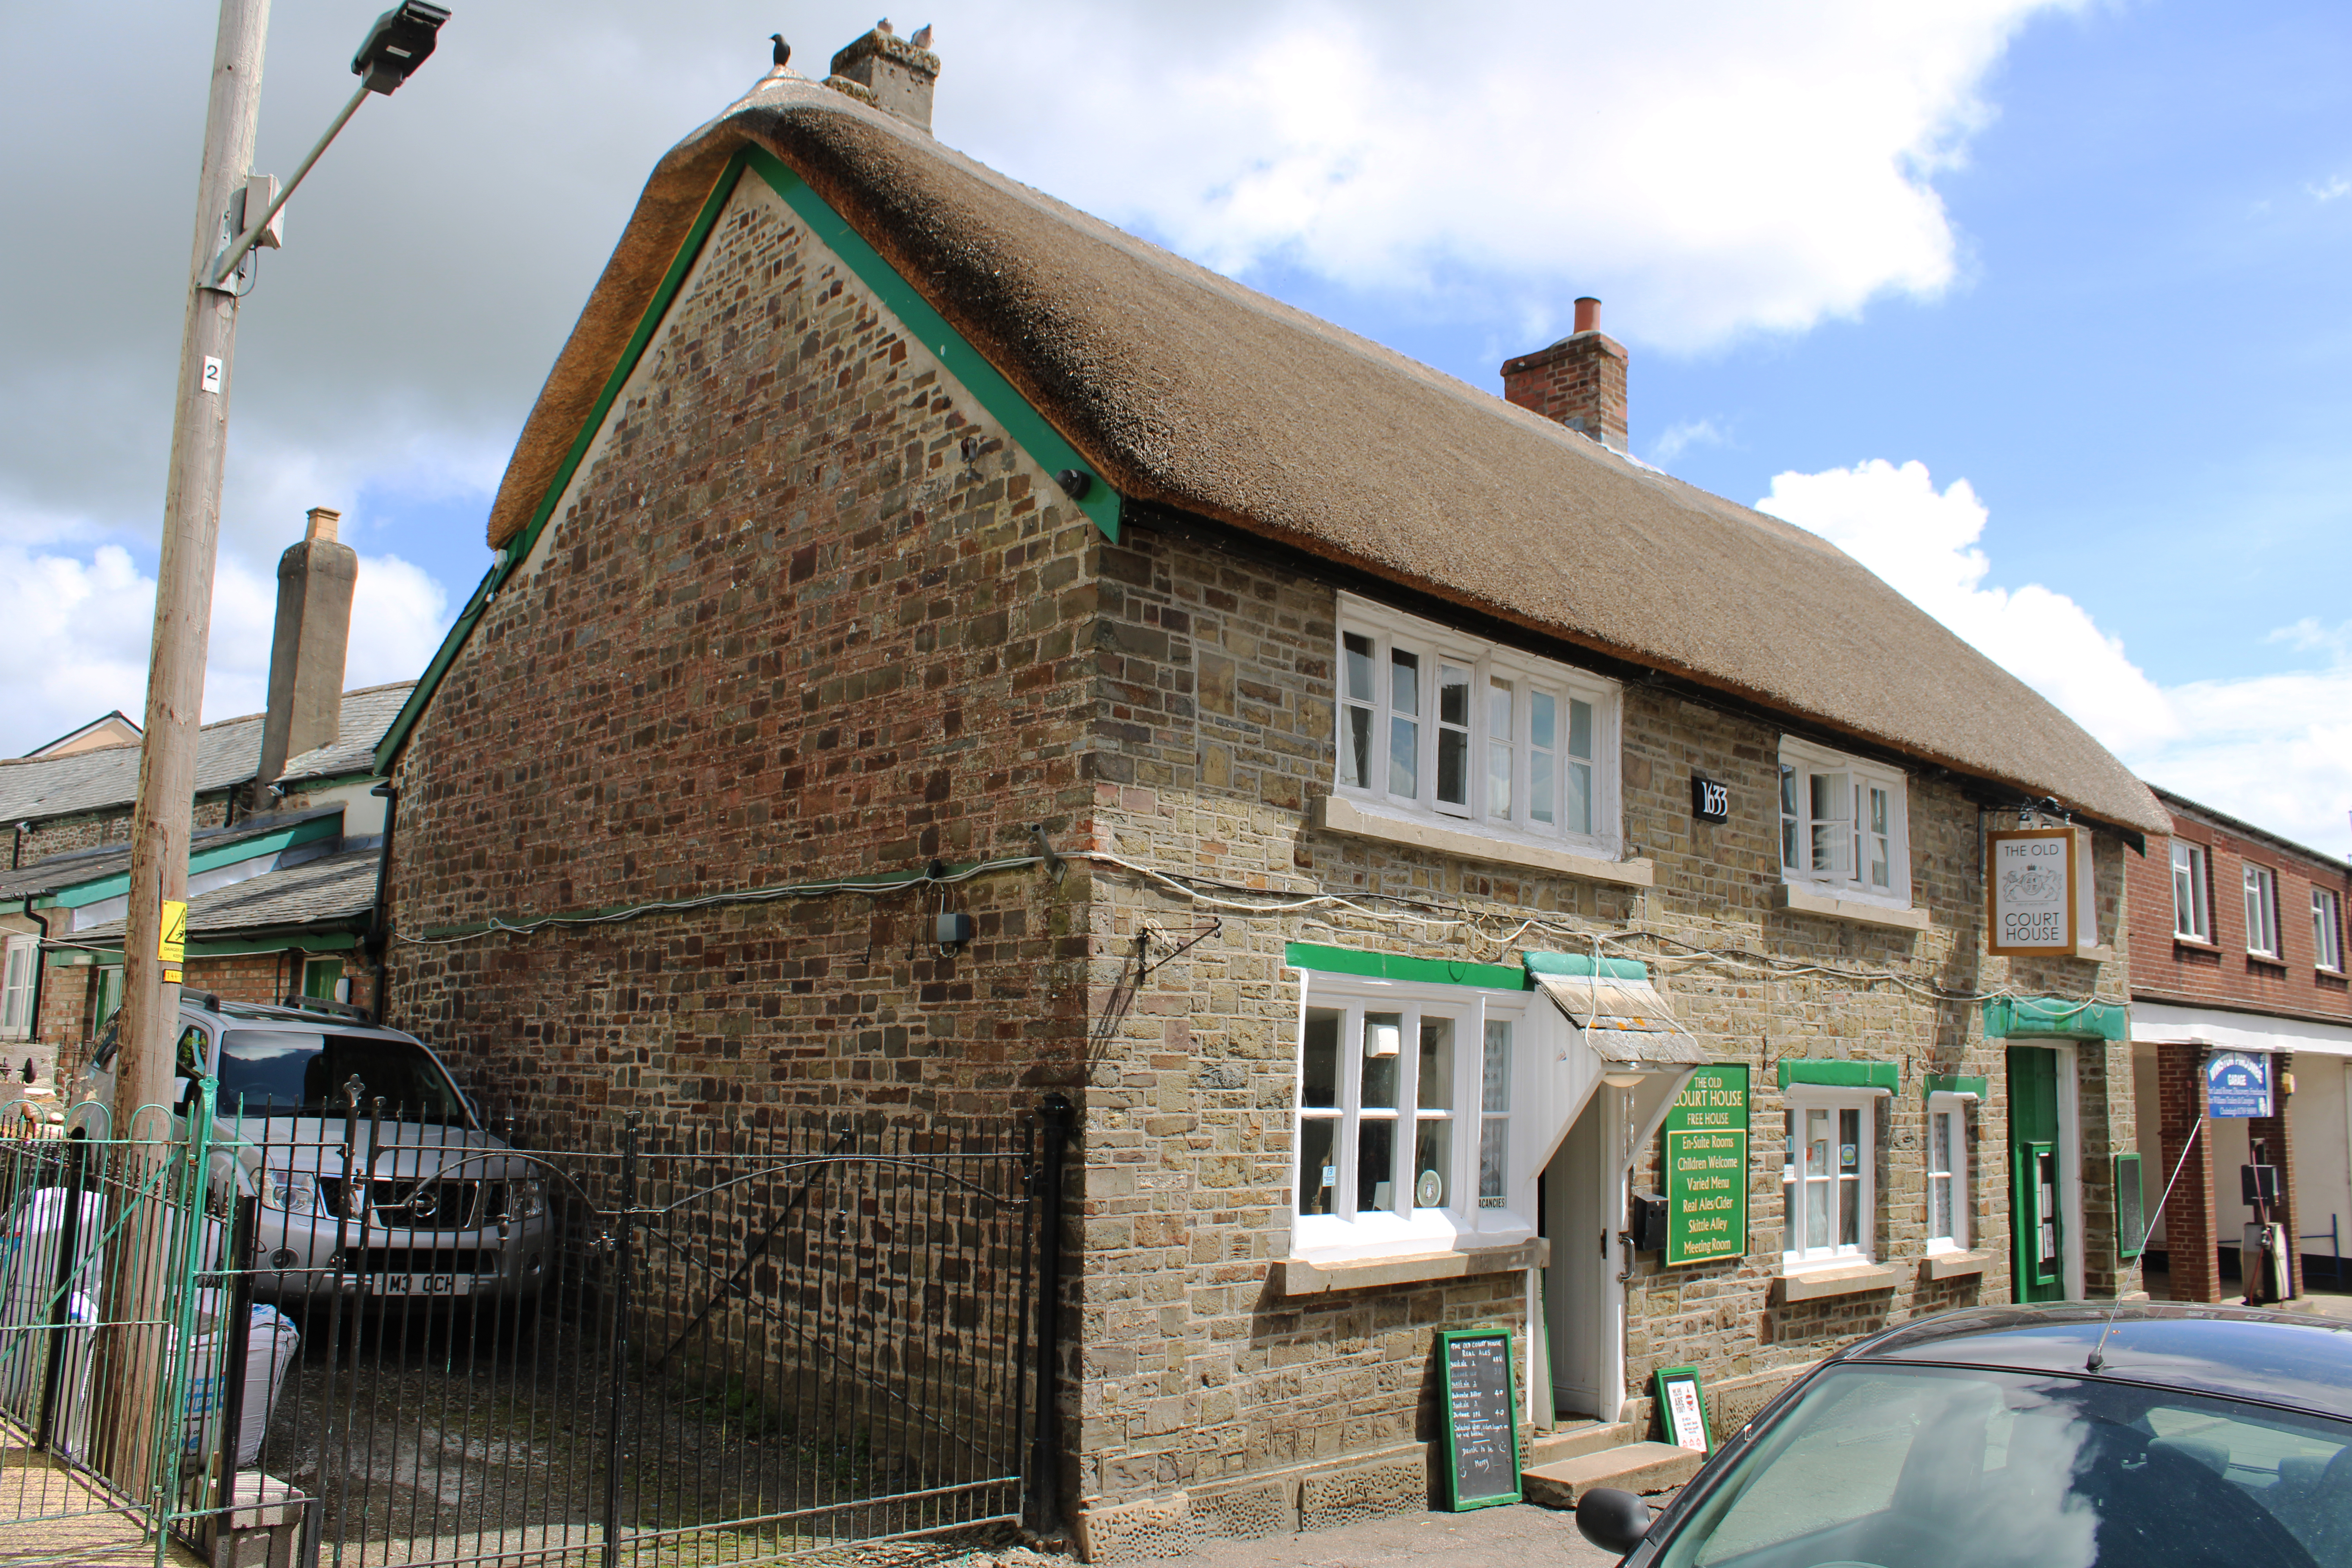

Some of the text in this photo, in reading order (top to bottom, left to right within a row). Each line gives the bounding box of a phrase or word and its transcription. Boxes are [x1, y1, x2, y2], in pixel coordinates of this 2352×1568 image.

[207, 365, 218, 381] 2
[1702, 781, 1728, 816] 1633
[2005, 844, 2058, 857] THE OLD
[2005, 913, 2060, 926] COURT
[2006, 927, 2059, 941] HOUSE
[1694, 1077, 1722, 1088] THE OLD
[2227, 1074, 2247, 1086] GARAGE
[1674, 1090, 1743, 1107] OURT HOUSE
[1687, 1112, 1730, 1125] FREE HOUSE
[1682, 1135, 1734, 1149] En-Suite Rooms
[1678, 1155, 1738, 1171] Children Welcome
[1687, 1176, 1730, 1191] Varied Menu
[1479, 1198, 1504, 1208] ACANCIES
[1683, 1196, 1734, 1212] Real Ales/Cider
[1688, 1217, 1728, 1233] Skittle Alley
[1684, 1238, 1731, 1255] Meeting Room
[1472, 1340, 1486, 1348] COURT
[1675, 1396, 1684, 1407] ARE
[1676, 1405, 1685, 1414] YOU?
